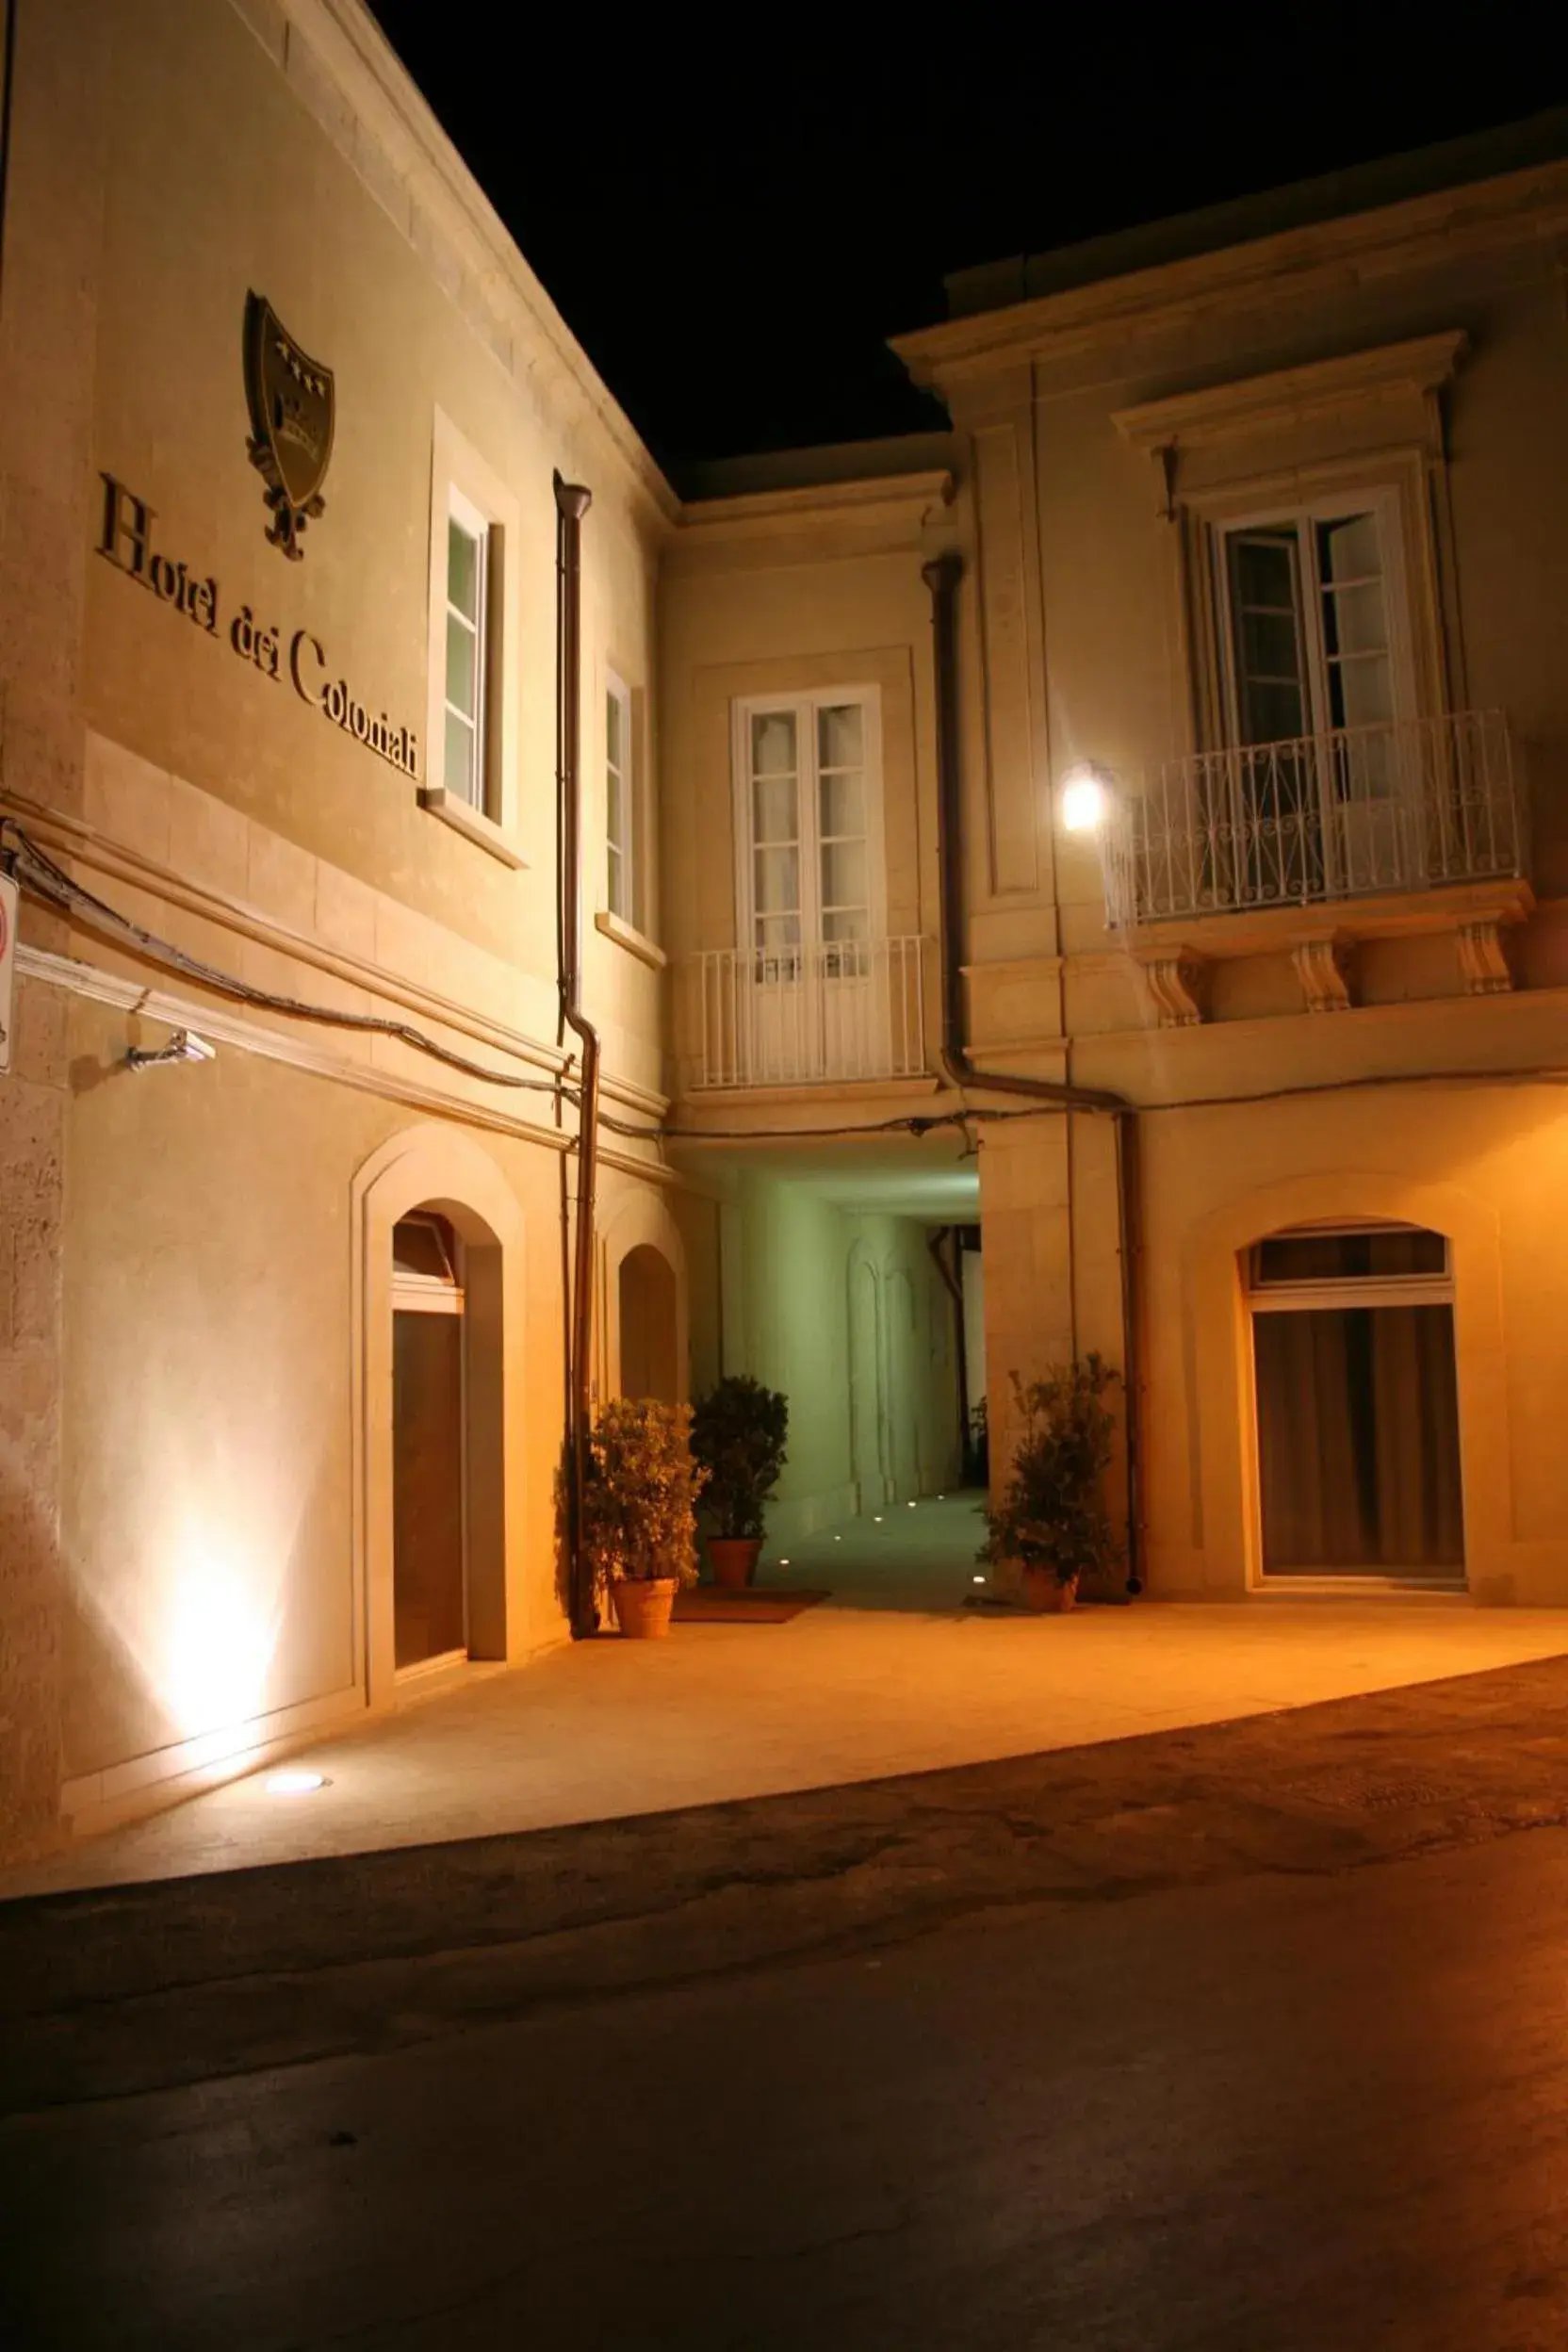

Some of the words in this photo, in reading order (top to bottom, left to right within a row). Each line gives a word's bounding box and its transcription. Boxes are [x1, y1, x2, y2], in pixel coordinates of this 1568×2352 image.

[94, 470, 220, 639] Hotel
[230, 605, 282, 682] dei
[289, 629, 418, 780] Coloniali
